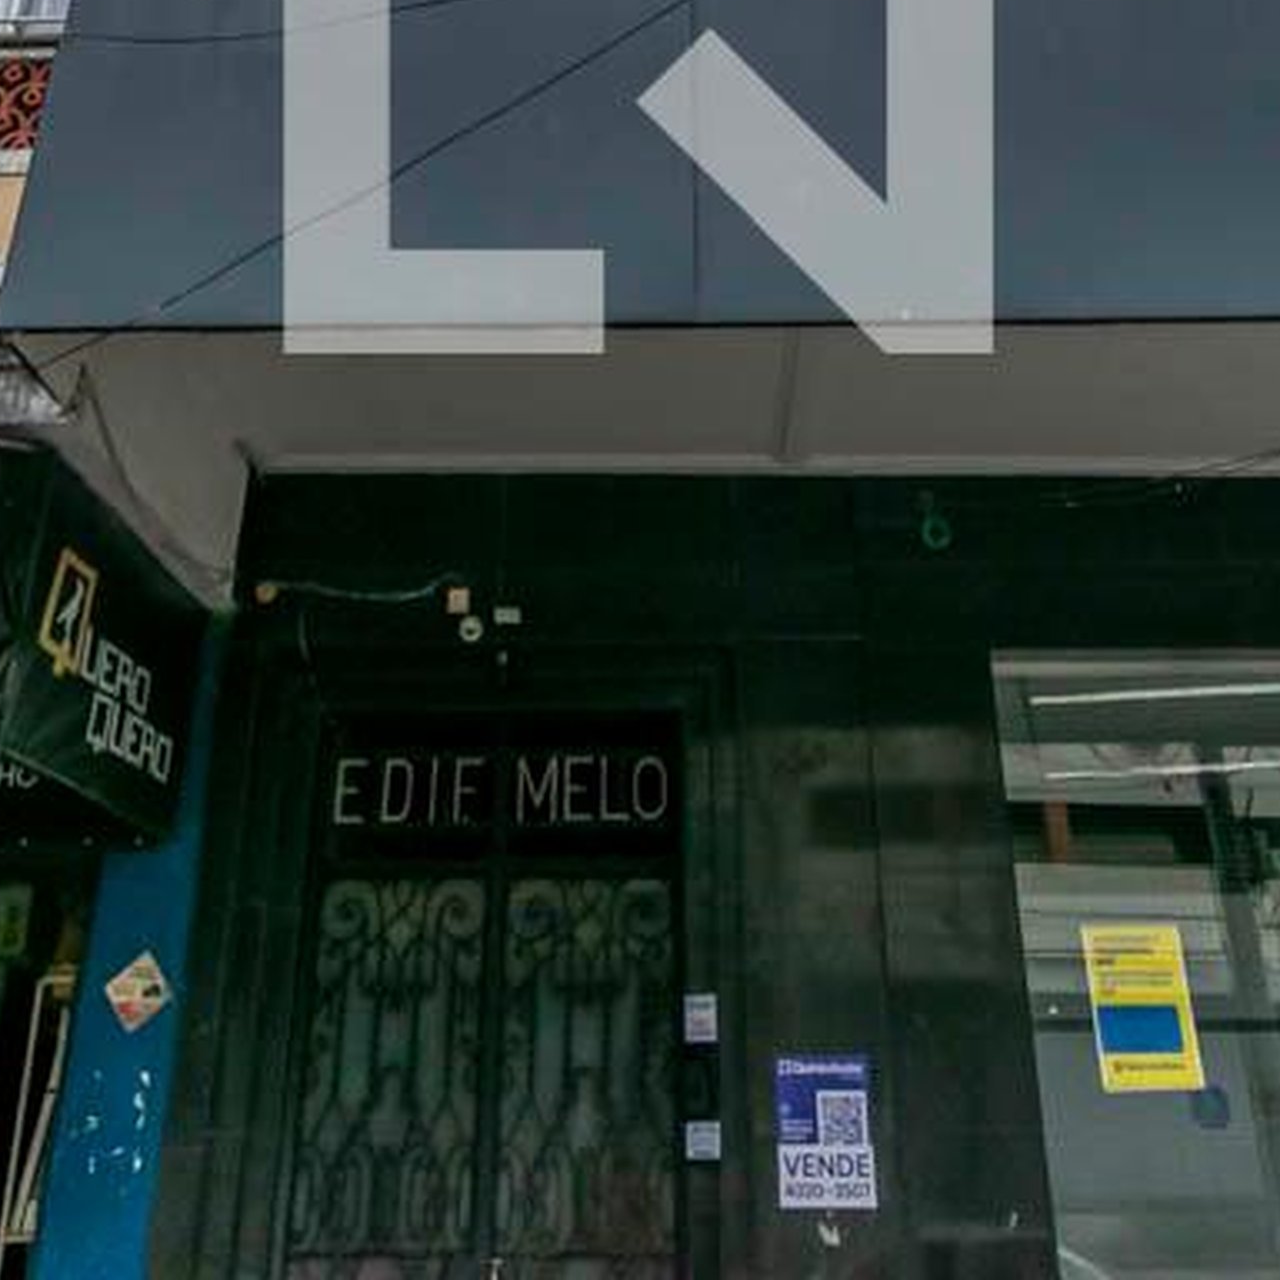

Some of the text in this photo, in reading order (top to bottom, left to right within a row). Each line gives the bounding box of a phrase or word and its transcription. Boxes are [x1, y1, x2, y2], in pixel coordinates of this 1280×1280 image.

[86, 693, 174, 785] QUERO
[516, 755, 668, 825] MELO
[783, 1152, 871, 1178] VENDE
